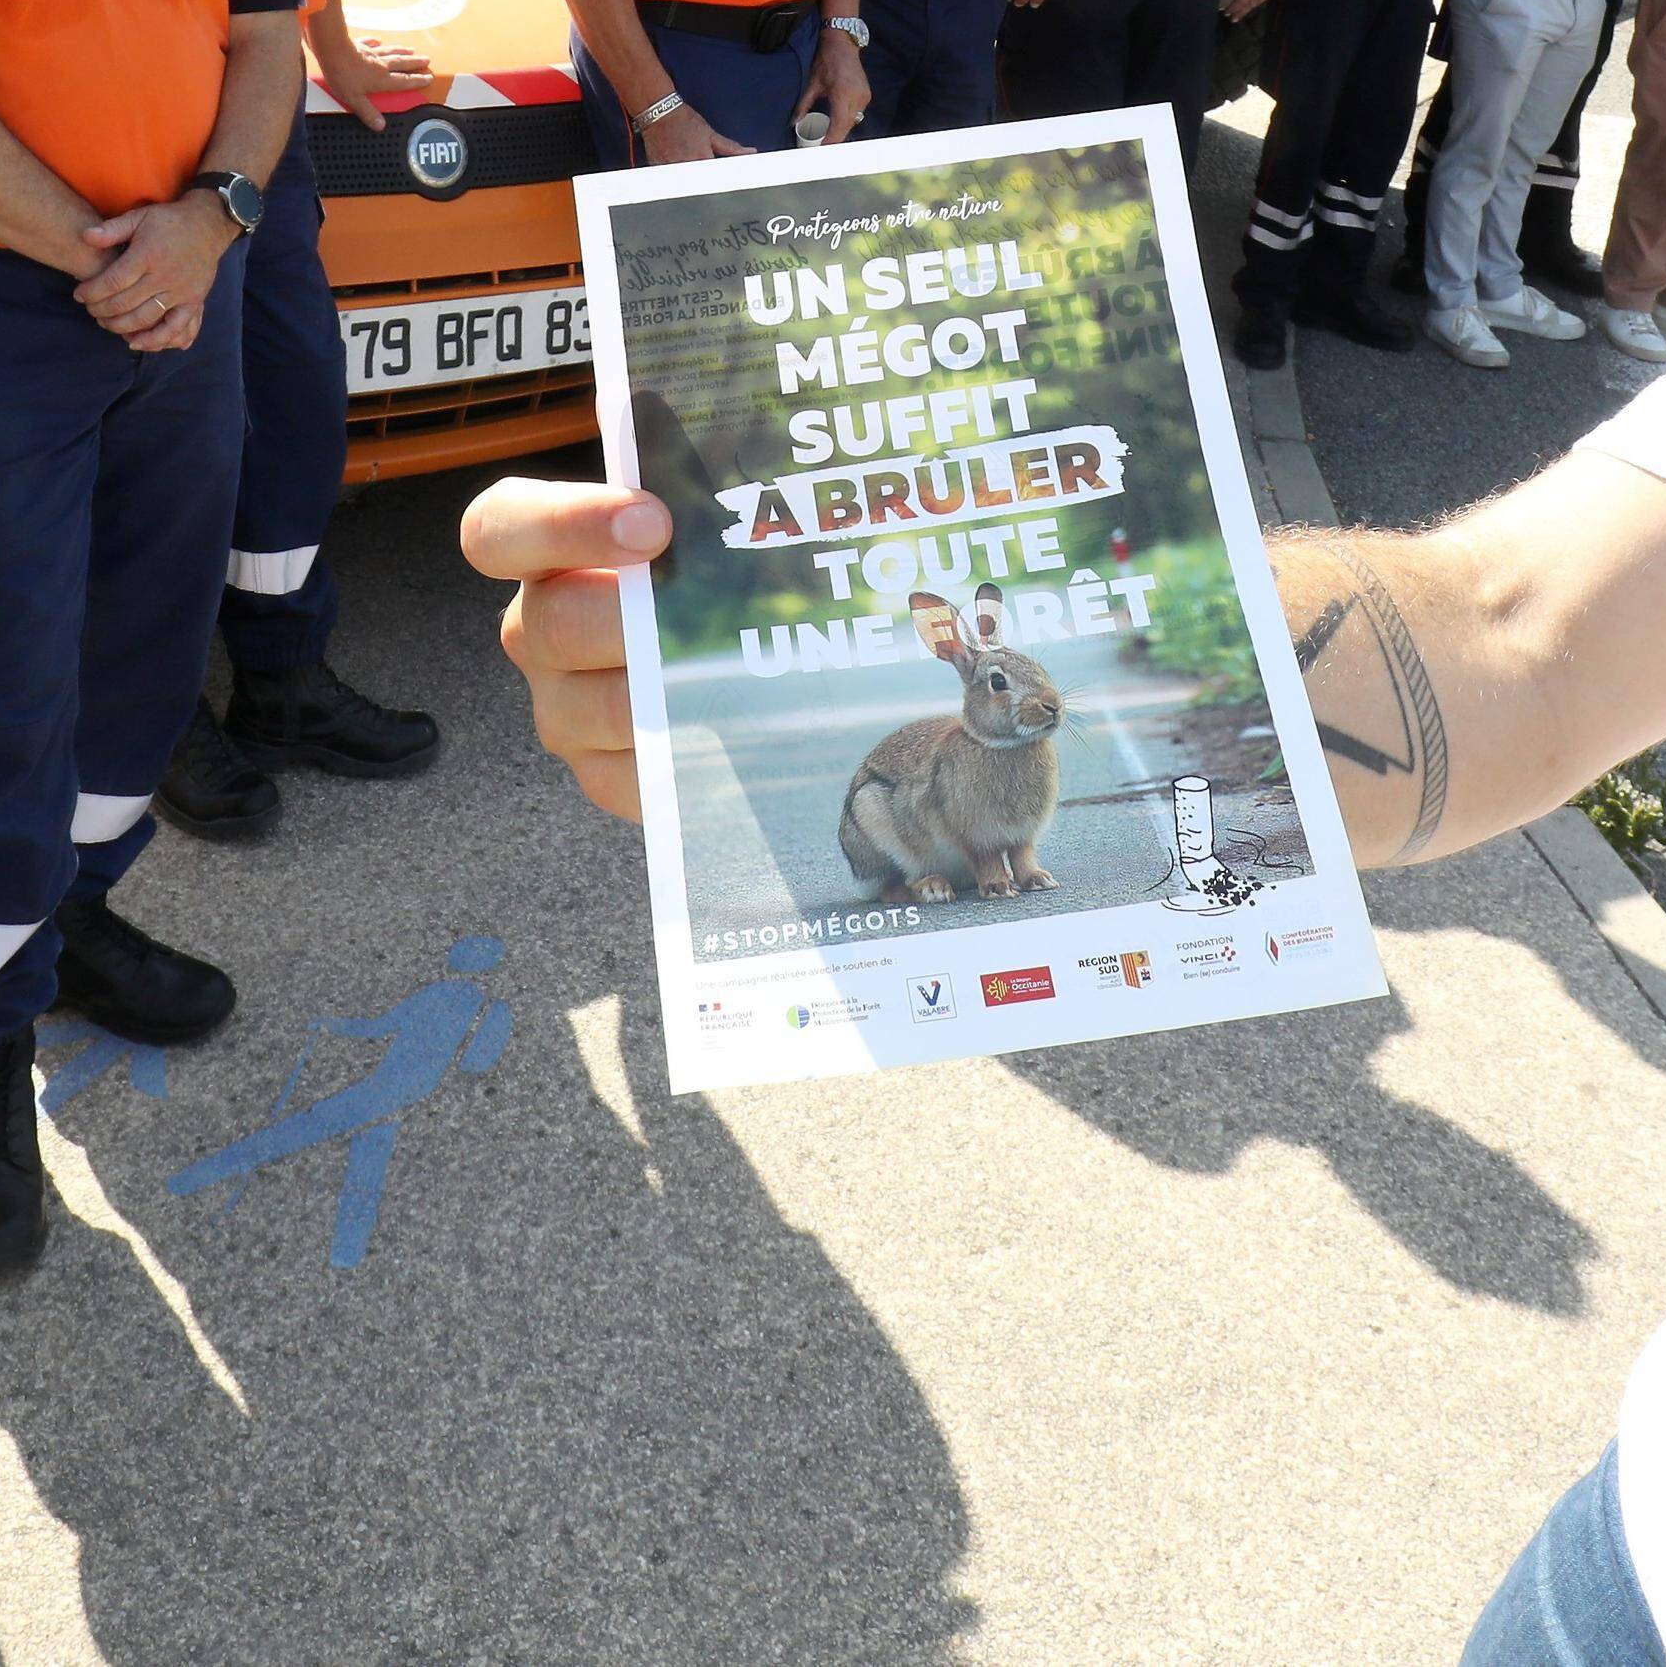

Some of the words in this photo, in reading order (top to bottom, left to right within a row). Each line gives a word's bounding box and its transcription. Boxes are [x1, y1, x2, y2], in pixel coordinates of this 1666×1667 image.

[418, 141, 459, 165] FIAT
[766, 207, 881, 251] Protégeons
[885, 198, 937, 233] notre
[937, 191, 1005, 221] nature
[743, 263, 850, 327] UN
[860, 239, 1043, 311] SEUL
[350, 317, 412, 380] 79
[436, 305, 523, 370] BFQ
[546, 297, 593, 356] 83
[775, 308, 1029, 396] MÉGOT
[787, 377, 1039, 465] SUFFIT
[813, 517, 1068, 601] TOUTE
[739, 613, 901, 679] UNE
[914, 567, 1157, 661] FORÊT
[702, 905, 922, 954] #STOPMÉGOTS
[1176, 935, 1234, 952] FONDATION
[842, 959, 878, 972] soutien
[1098, 964, 1120, 976] SUD
[1180, 953, 1218, 964] VINCI
[1183, 970, 1199, 980] Bien
[1012, 979, 1050, 991] Occitanie
